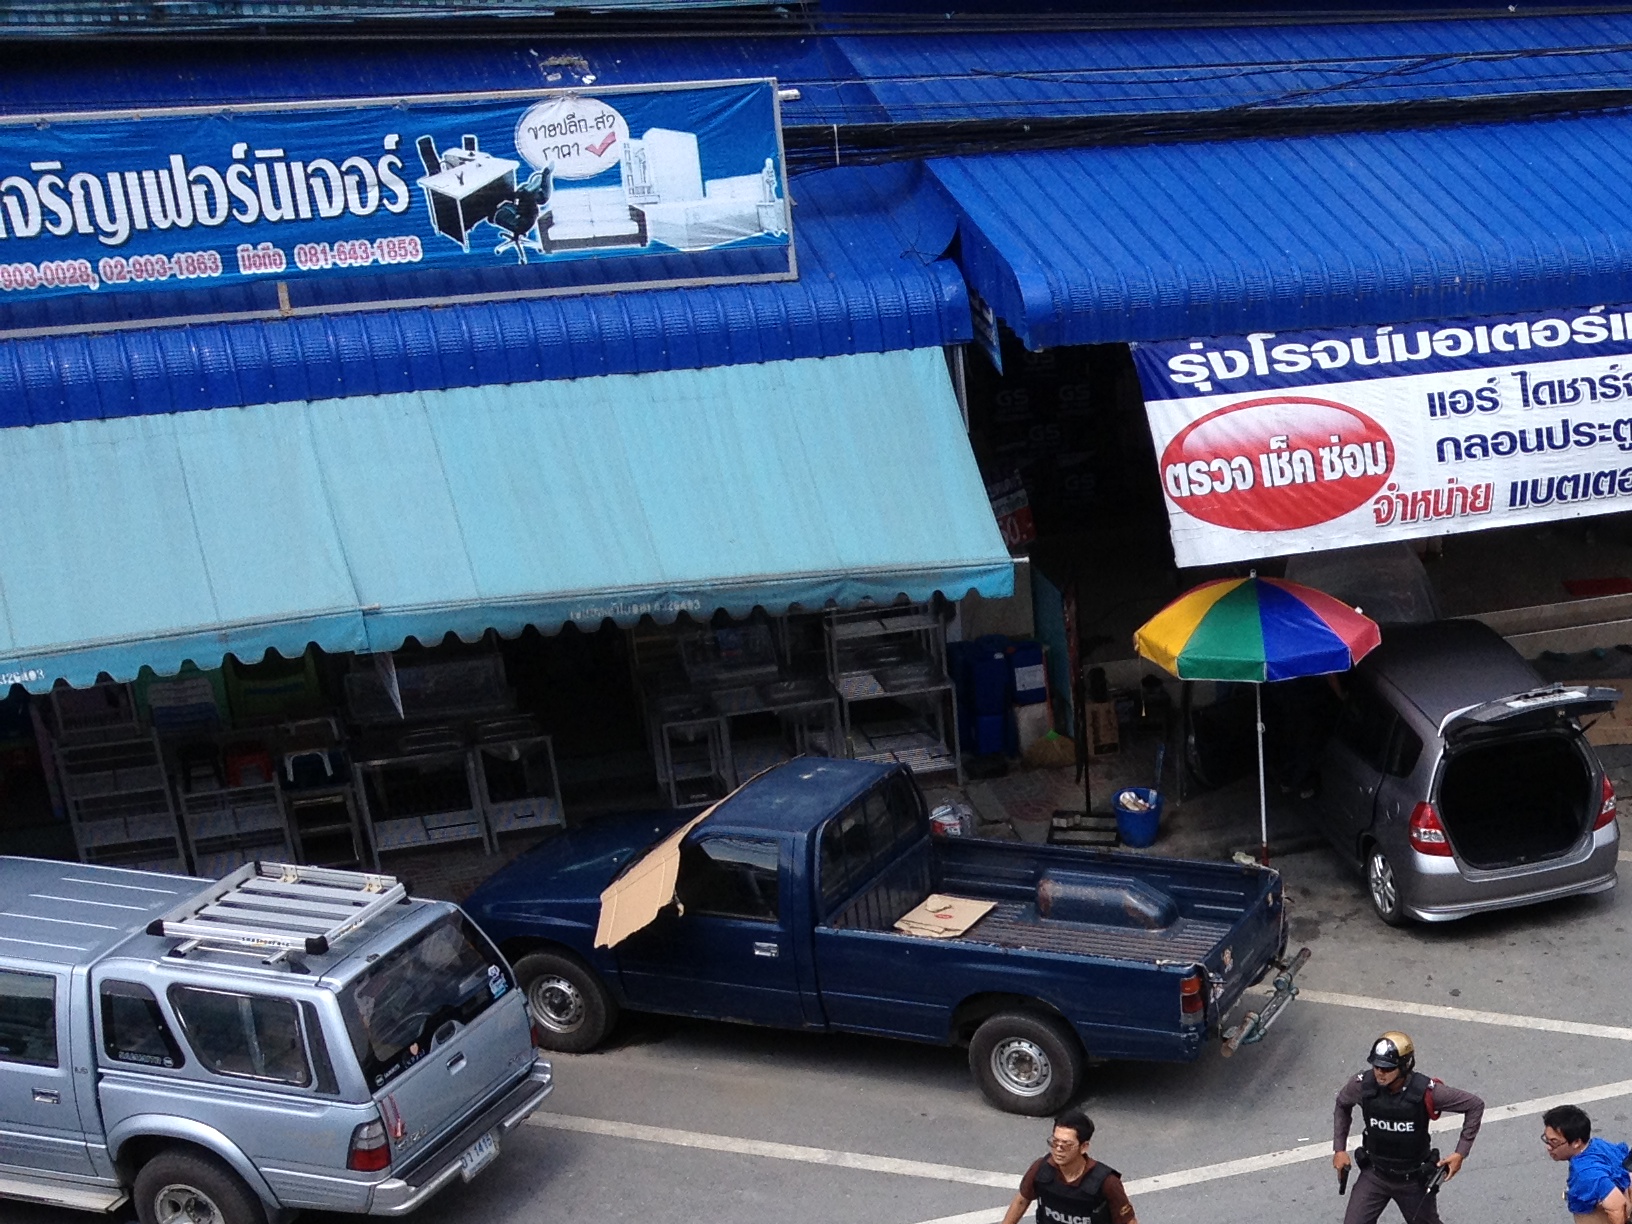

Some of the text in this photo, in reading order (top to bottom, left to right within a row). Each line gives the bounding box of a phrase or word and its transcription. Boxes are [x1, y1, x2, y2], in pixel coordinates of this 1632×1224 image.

[0, 133, 410, 246] จริญเฟอร์นิเจอร์
[100, 252, 221, 283] 02-903-1863
[294, 235, 422, 269] 081-643-1853
[1426, 376, 1501, 419] แอร์
[1165, 434, 1388, 498] ตรวจ เช็ค ซ่อม
[1372, 476, 1495, 526] จำหน่าย
[1369, 1117, 1416, 1132] POLICE
